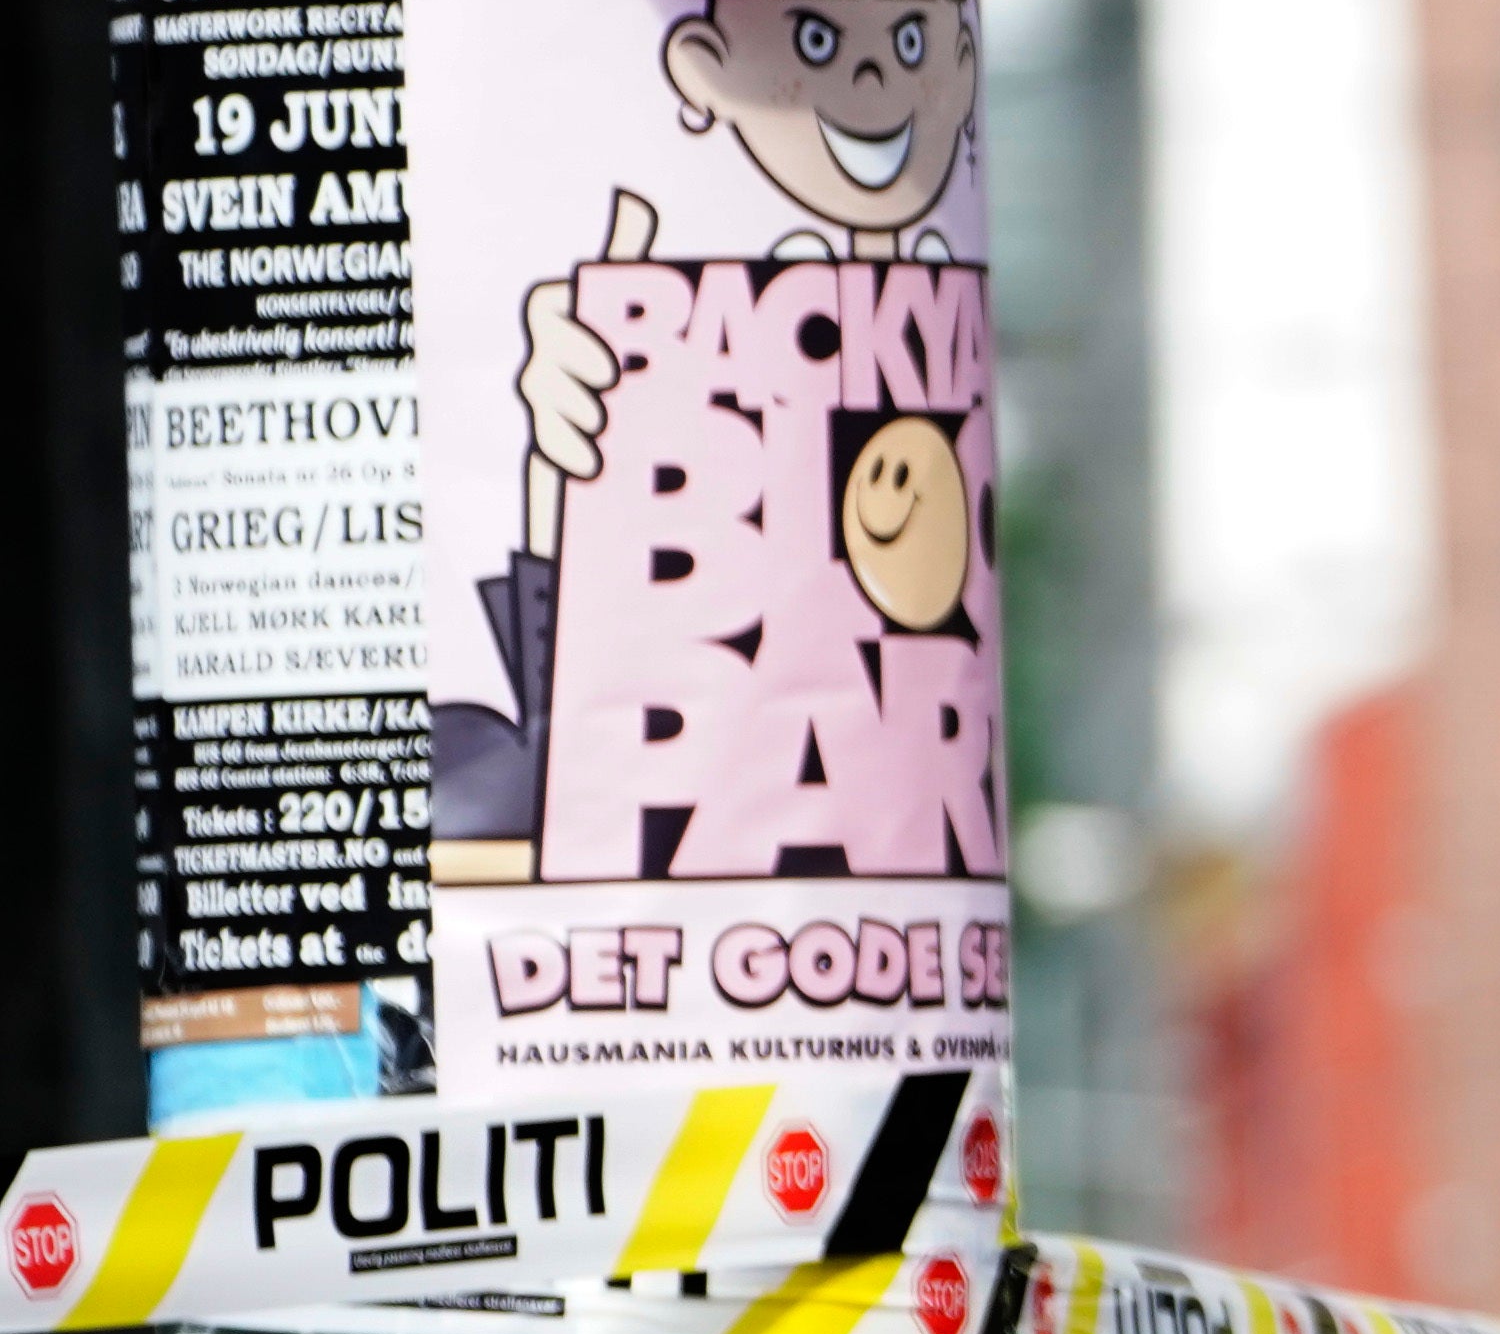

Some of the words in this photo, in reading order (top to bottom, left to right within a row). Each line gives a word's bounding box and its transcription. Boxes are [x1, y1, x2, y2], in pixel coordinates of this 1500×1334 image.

[154, 8, 301, 44] MASTERWORK
[193, 93, 255, 156] 19
[162, 173, 297, 234] SVEIN
[178, 248, 228, 289] THE
[361, 462, 391, 484] Op
[189, 570, 297, 597] Norwegian
[175, 610, 238, 637] KJELL
[249, 604, 330, 630] MØRK
[177, 649, 273, 680] HARALD
[173, 702, 268, 740] KAMPEN
[182, 804, 261, 838] Tickets
[174, 837, 390, 874] TICKETMASTER.NO
[186, 878, 296, 918] Billetter
[300, 872, 368, 912] ved
[180, 925, 293, 971] Tickets
[299, 923, 346, 966] at
[355, 942, 387, 965] the
[397, 919, 432, 964] d
[488, 925, 682, 1017] DET
[712, 918, 945, 1008] GODE
[498, 1040, 713, 1066] HAUSMANIA
[730, 1036, 895, 1061] KULTURHUS
[254, 1114, 605, 1249] POLITI
[768, 1150, 826, 1189] STOP
[15, 1225, 71, 1267] STOP
[919, 1280, 967, 1319] STOP
